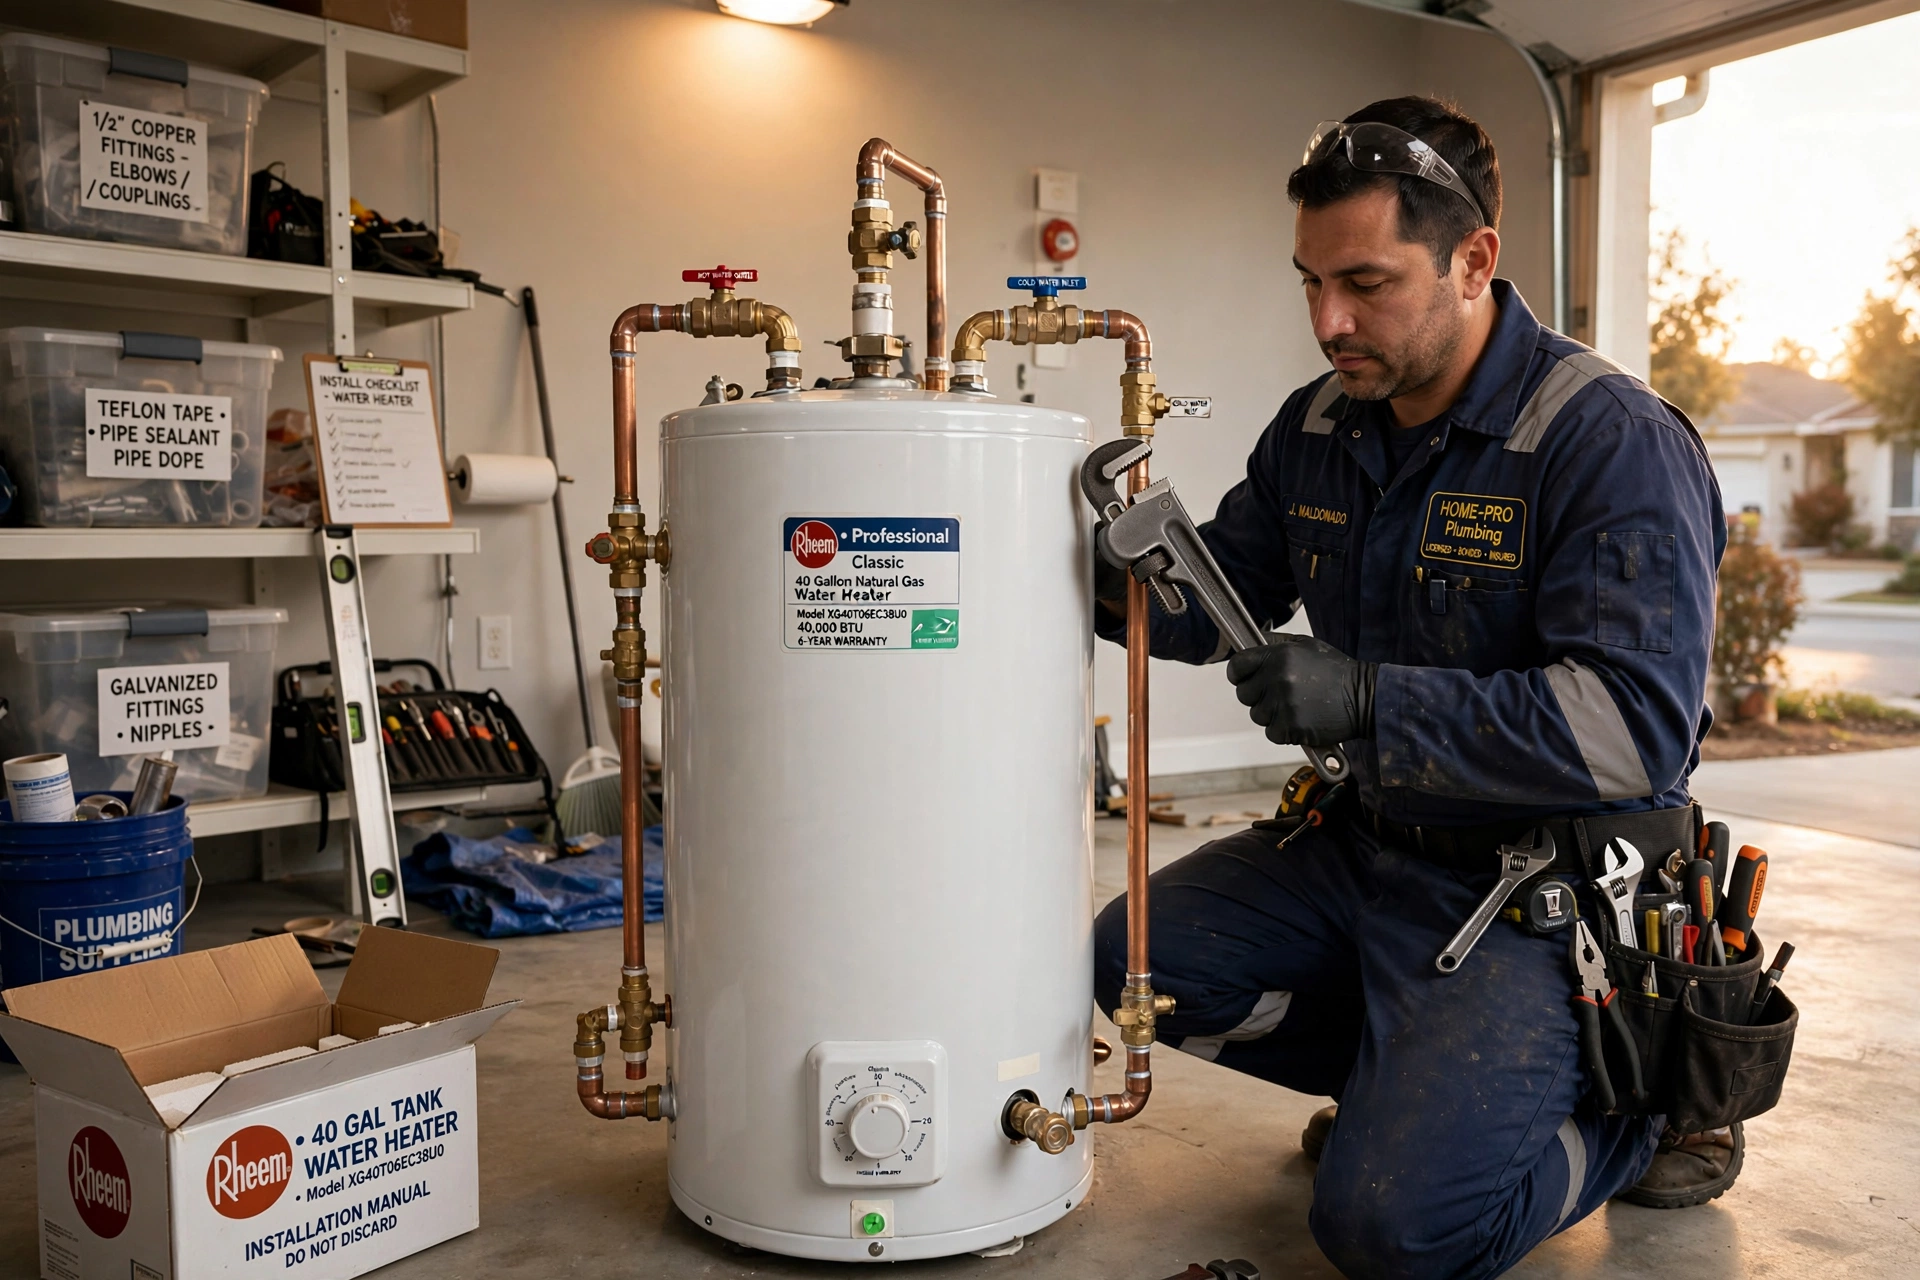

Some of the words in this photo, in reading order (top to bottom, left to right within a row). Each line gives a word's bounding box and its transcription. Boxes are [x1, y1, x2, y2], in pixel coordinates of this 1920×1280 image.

[93, 111, 125, 132] 1/2"
[131, 118, 196, 146] COPPER
[101, 136, 175, 164] FITTINGS
[110, 160, 177, 186] ELBOWS
[1017, 278, 1036, 287] COLD
[319, 374, 363, 389] INSTALL
[364, 378, 420, 393] CHECKLIST
[332, 391, 371, 404] WATER
[373, 393, 414, 407] HEATER
[97, 399, 166, 420] TEFLON
[172, 404, 214, 423] TAPE
[99, 423, 139, 443] PIPE
[145, 426, 221, 446] SEALANT
[114, 449, 152, 467] PIPE
[158, 450, 205, 469] DOPE
[1288, 502, 1297, 516] J.
[1298, 504, 1347, 525] MALDONADO
[1440, 500, 1514, 523] HOME-PRO
[794, 525, 835, 558] Rheem
[851, 527, 949, 544] Professional
[1445, 519, 1503, 546] Plumbing
[852, 554, 904, 569] Classic
[795, 575, 811, 587] 40
[813, 574, 852, 587] Gallon
[855, 574, 899, 587] Natural
[901, 575, 925, 588] Gas
[794, 588, 836, 602] Water
[841, 588, 892, 602] Heater
[797, 608, 825, 619] Model
[840, 622, 864, 634] BTU
[797, 636, 832, 646] 6-YEAR
[833, 636, 888, 646] WARRANTY
[110, 673, 218, 696] GALVANIZED
[126, 697, 204, 719] FITTINGS
[130, 720, 203, 743] NIPPLES
[55, 902, 173, 943] PLUMBING
[311, 1119, 338, 1146] 40
[344, 1106, 386, 1137] GAL
[390, 1086, 444, 1123] TANK
[303, 1136, 379, 1180] WATER
[384, 1110, 459, 1155] HEATER
[73, 1136, 128, 1214] Rheem
[213, 1140, 288, 1206] Rheem
[306, 1176, 345, 1203] Model
[244, 1203, 363, 1261] INSTALLATION
[367, 1180, 431, 1217] MANUAL
[285, 1248, 306, 1268] DO
[310, 1235, 338, 1260] NOT
[341, 1214, 398, 1248] DISCARD
